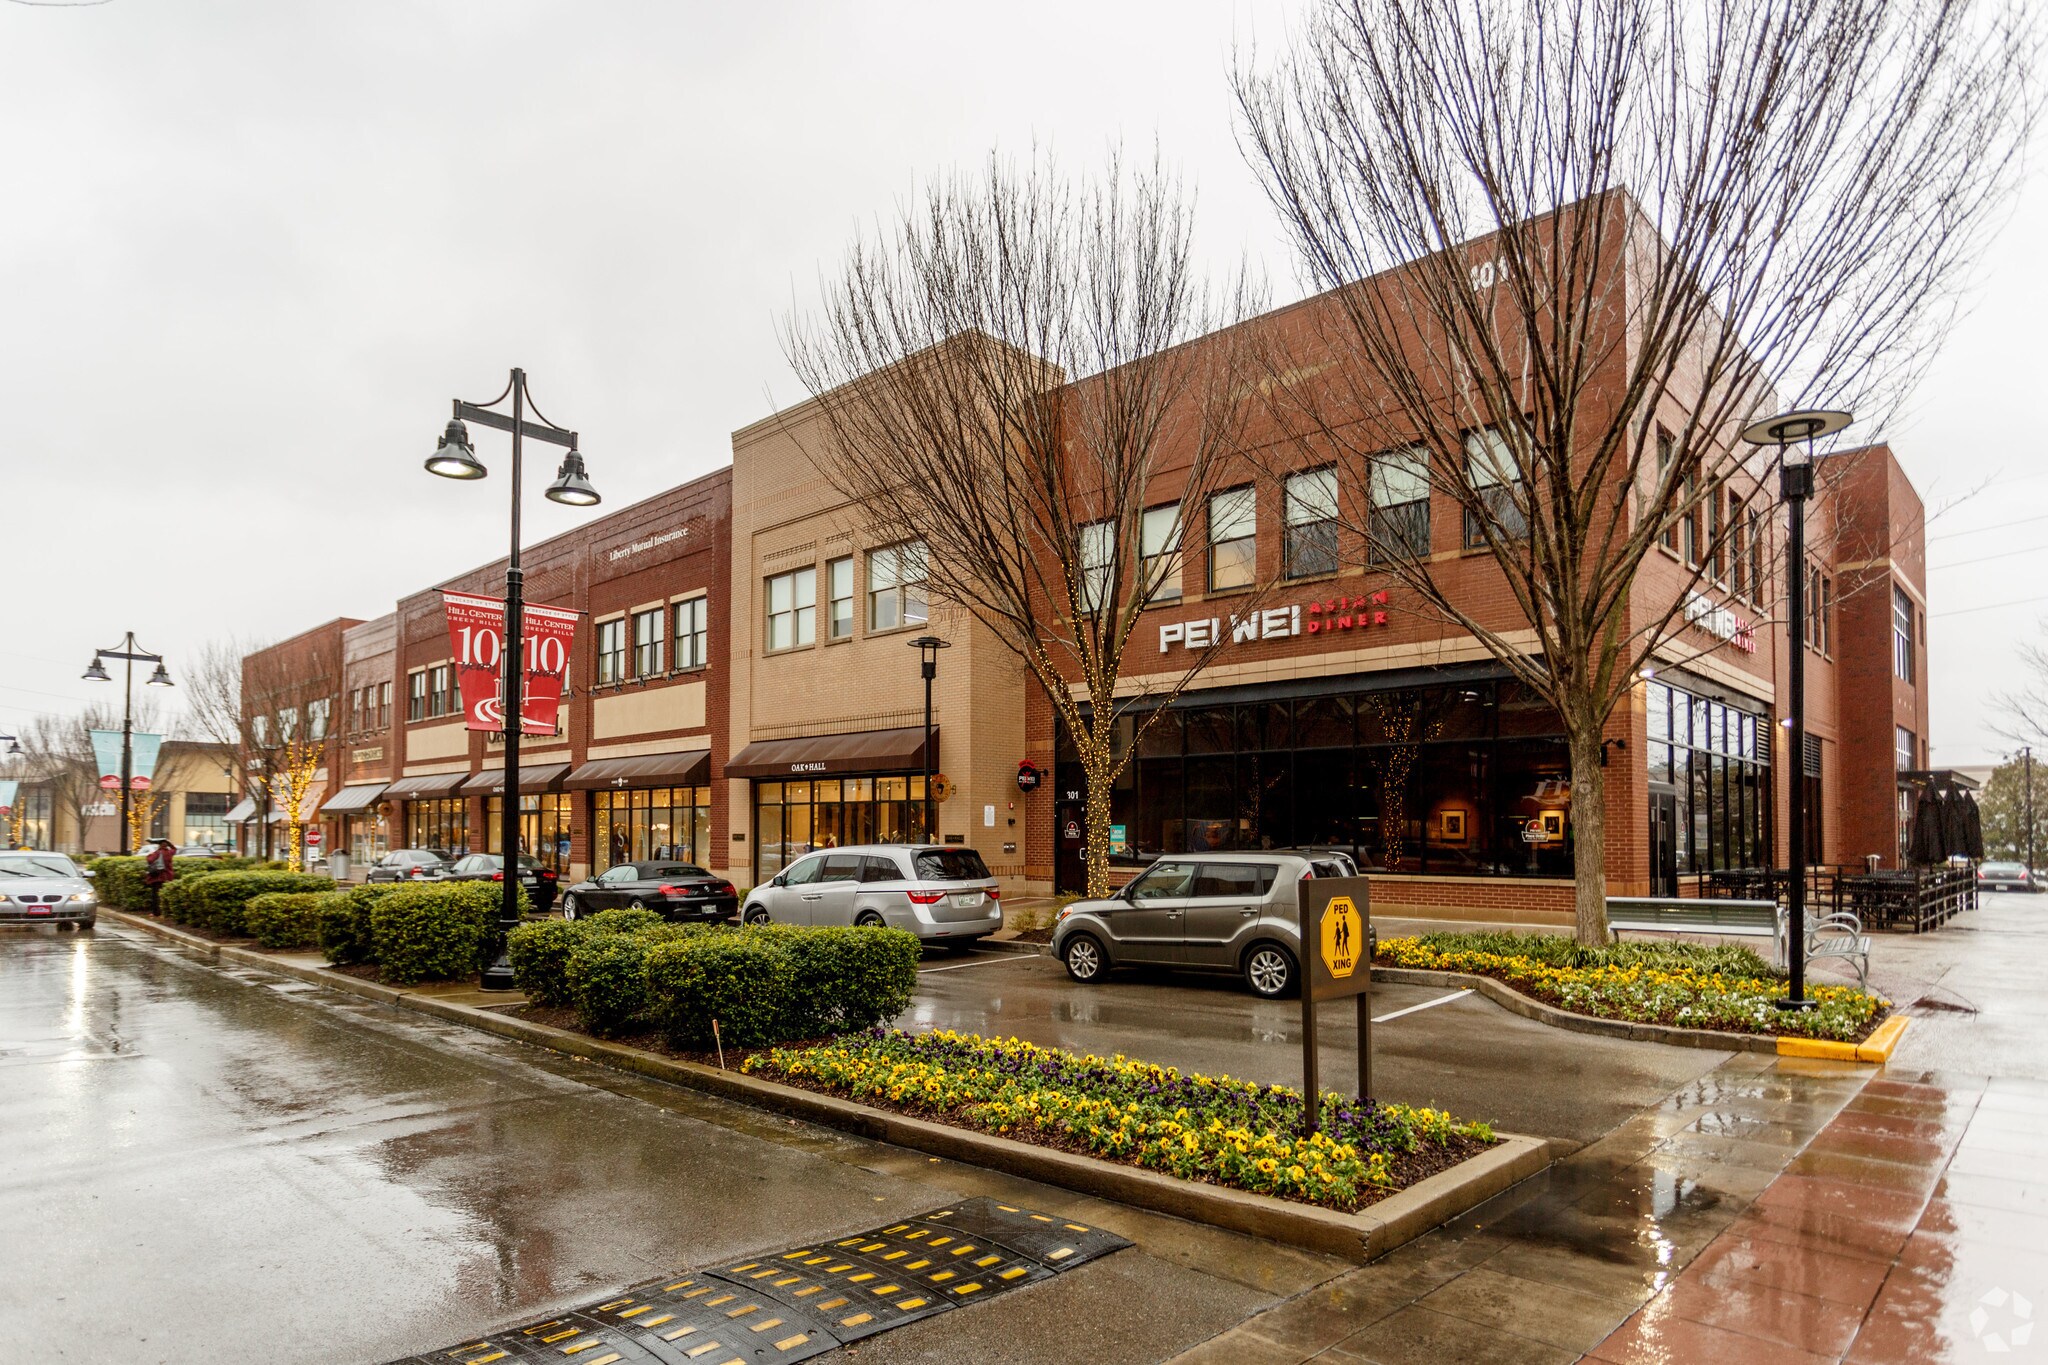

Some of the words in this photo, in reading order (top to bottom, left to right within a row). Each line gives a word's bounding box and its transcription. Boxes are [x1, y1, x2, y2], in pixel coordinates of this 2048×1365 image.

[610, 546, 631, 561] Liberty
[632, 536, 653, 554] Mutual
[654, 527, 688, 546] Insurance
[1308, 590, 1389, 614] ASIAN
[447, 615, 475, 624] GREEN
[479, 619, 503, 627] HILLS
[448, 606, 468, 616] HILL
[469, 609, 503, 621] CENTER
[525, 616, 543, 626] HILL
[544, 619, 575, 631] CENTER
[1159, 617, 1221, 653] PEI
[1229, 604, 1301, 643] WEI
[1307, 611, 1388, 634] DINER
[525, 625, 550, 633] GREEN
[553, 629, 574, 637] HILLS
[457, 626, 500, 668] 10
[526, 634, 565, 675] 10
[791, 763, 805, 772] OAK
[808, 762, 826, 771] HALL
[1333, 904, 1349, 914] PED
[1333, 958, 1352, 970] XING
